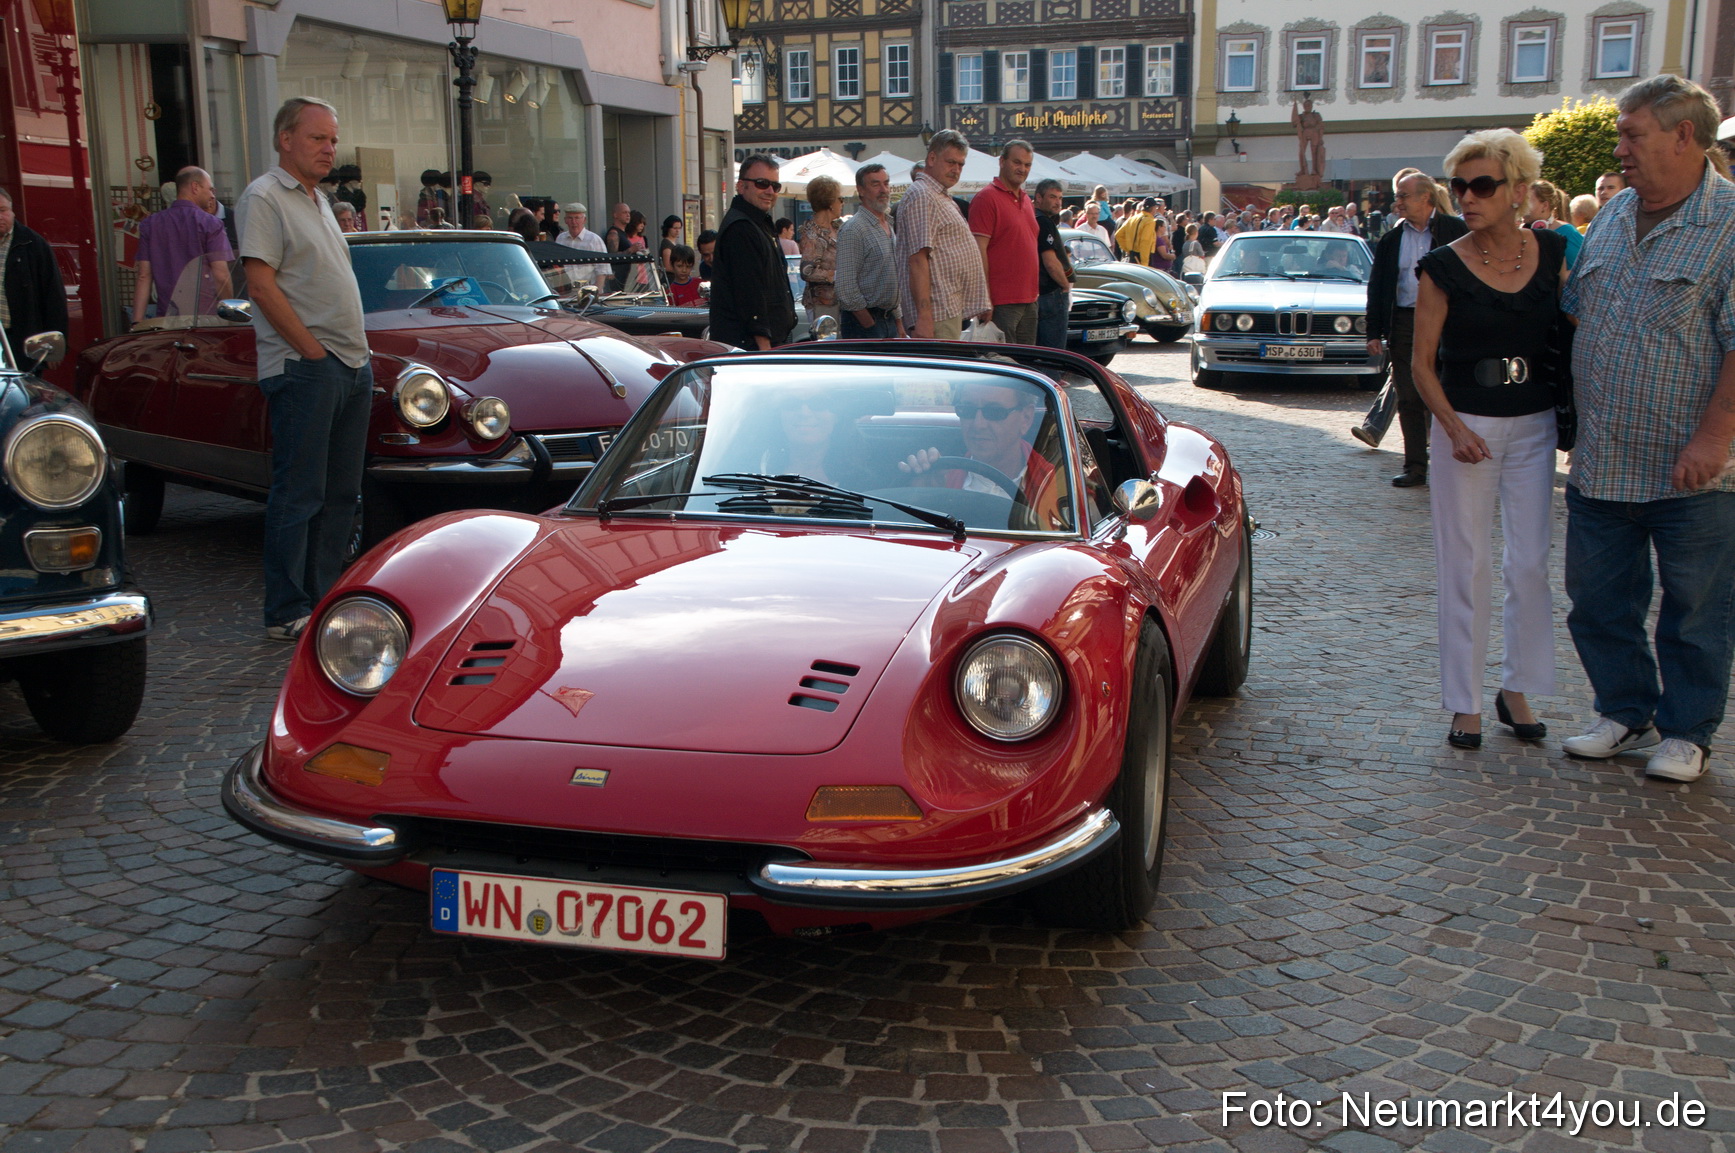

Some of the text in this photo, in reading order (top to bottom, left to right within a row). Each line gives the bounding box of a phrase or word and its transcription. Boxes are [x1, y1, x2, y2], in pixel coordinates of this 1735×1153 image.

[1015, 110, 1108, 132] Engel Apotheke
[1265, 346, 1284, 357] MSP
[1289, 347, 1296, 357] C
[440, 907, 450, 920] D
[463, 880, 706, 949] WN 07062
